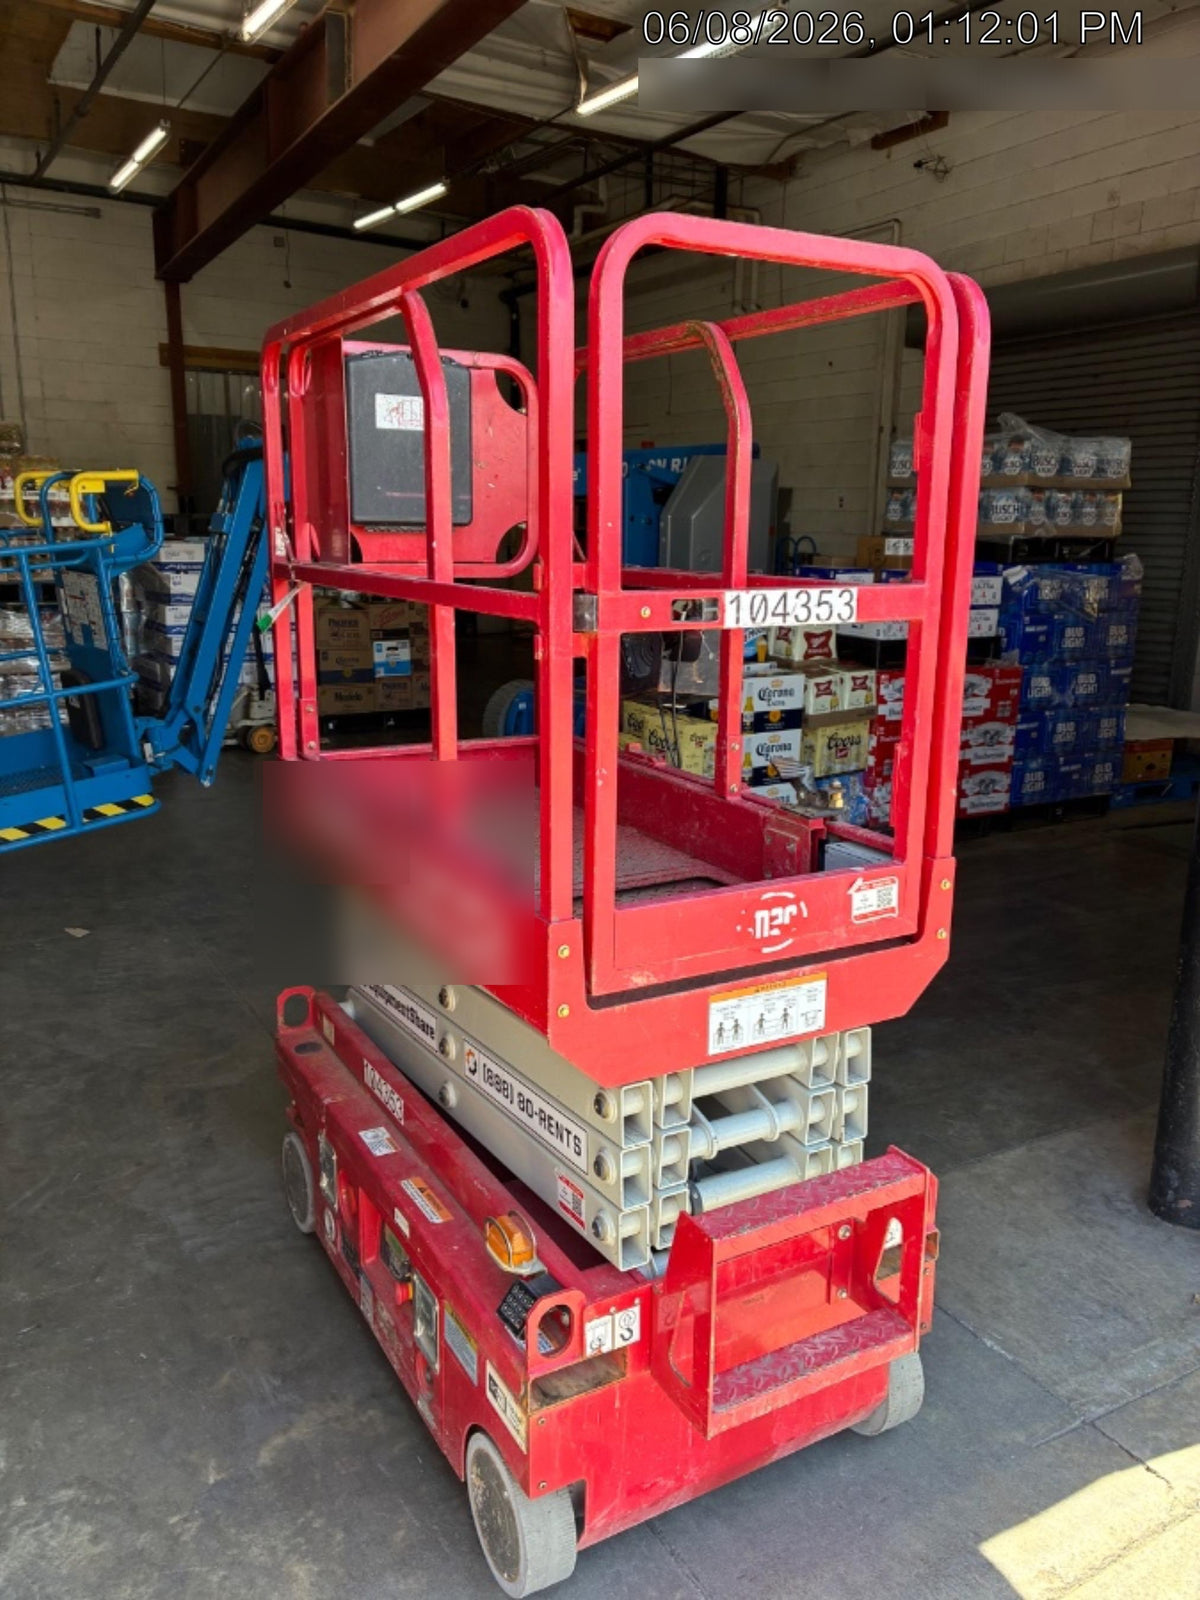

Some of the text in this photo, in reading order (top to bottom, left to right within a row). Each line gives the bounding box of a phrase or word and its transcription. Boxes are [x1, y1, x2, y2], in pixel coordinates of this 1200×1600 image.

[991, 504, 1021, 516] BUSCH
[729, 588, 855, 625] 104353
[758, 687, 795, 701] Corona
[756, 742, 792, 756] Corona
[827, 732, 861, 750] Coors
[365, 1062, 403, 1121] 104353
[482, 1062, 582, 1156] (888) 80-RENTS
